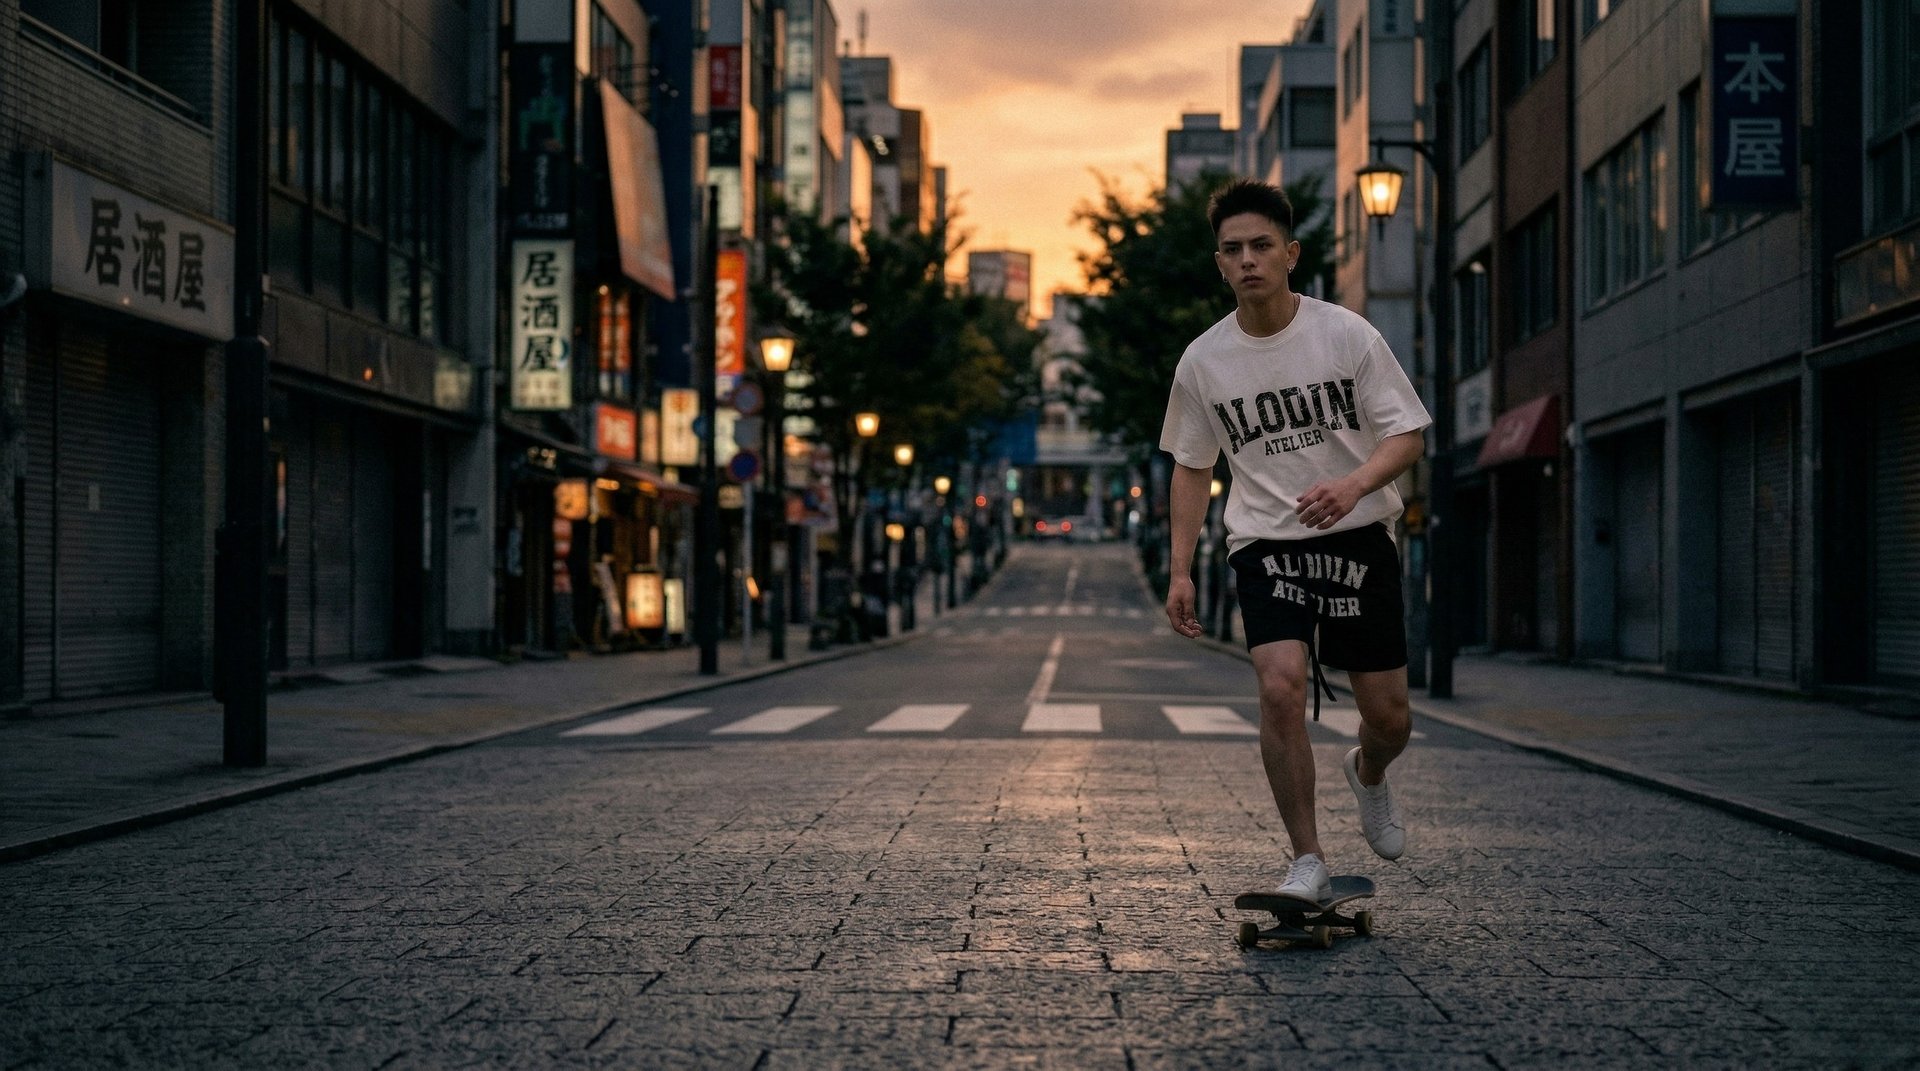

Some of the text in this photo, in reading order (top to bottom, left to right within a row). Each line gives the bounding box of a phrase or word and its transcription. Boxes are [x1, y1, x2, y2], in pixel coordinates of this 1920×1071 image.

[1724, 41, 1786, 177] 本屋
[85, 197, 206, 313] 居酒屋
[520, 251, 559, 373] 居酒屋
[1213, 378, 1361, 456] ALODIN
[1264, 428, 1325, 457] ATELIER
